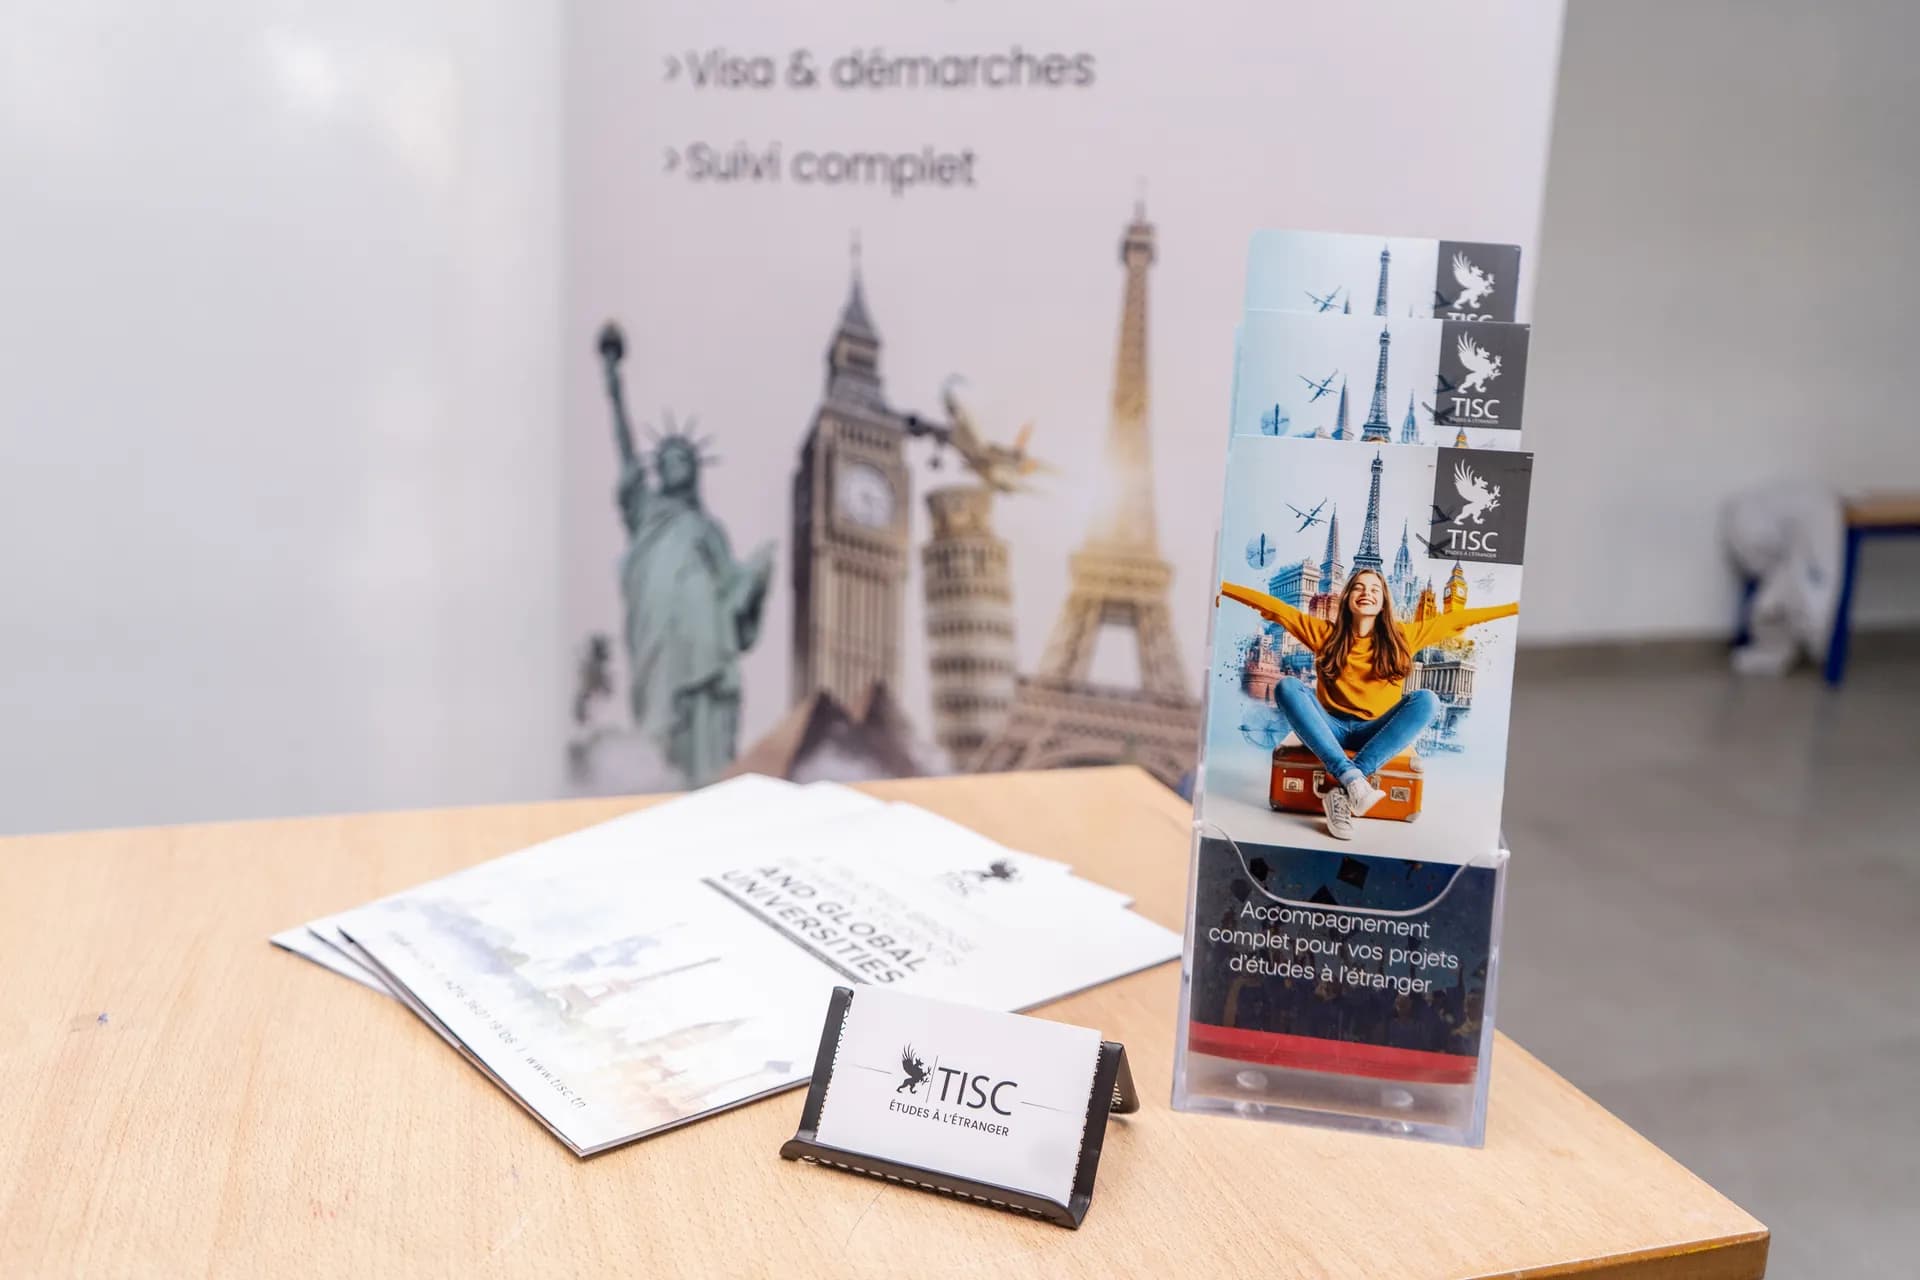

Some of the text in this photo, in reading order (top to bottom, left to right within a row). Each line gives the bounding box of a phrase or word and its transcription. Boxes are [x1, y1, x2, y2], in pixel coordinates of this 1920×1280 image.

[686, 46, 1096, 90] Visa & démarches
[687, 141, 976, 196] Suivi complet
[1451, 397, 1500, 419] TISC
[1447, 529, 1498, 552] TISC
[721, 869, 904, 985] UNIVERSITIES
[759, 866, 816, 899] AND
[816, 900, 927, 972] GLOBAL
[1240, 900, 1430, 939] Accompagnement
[1209, 926, 1459, 971] complet pour vos projets
[1229, 953, 1432, 995] d'études à l'étranger
[938, 1066, 1018, 1116] TISC
[888, 1100, 1010, 1137] ÉTUDES À L'ÉTRANGER
